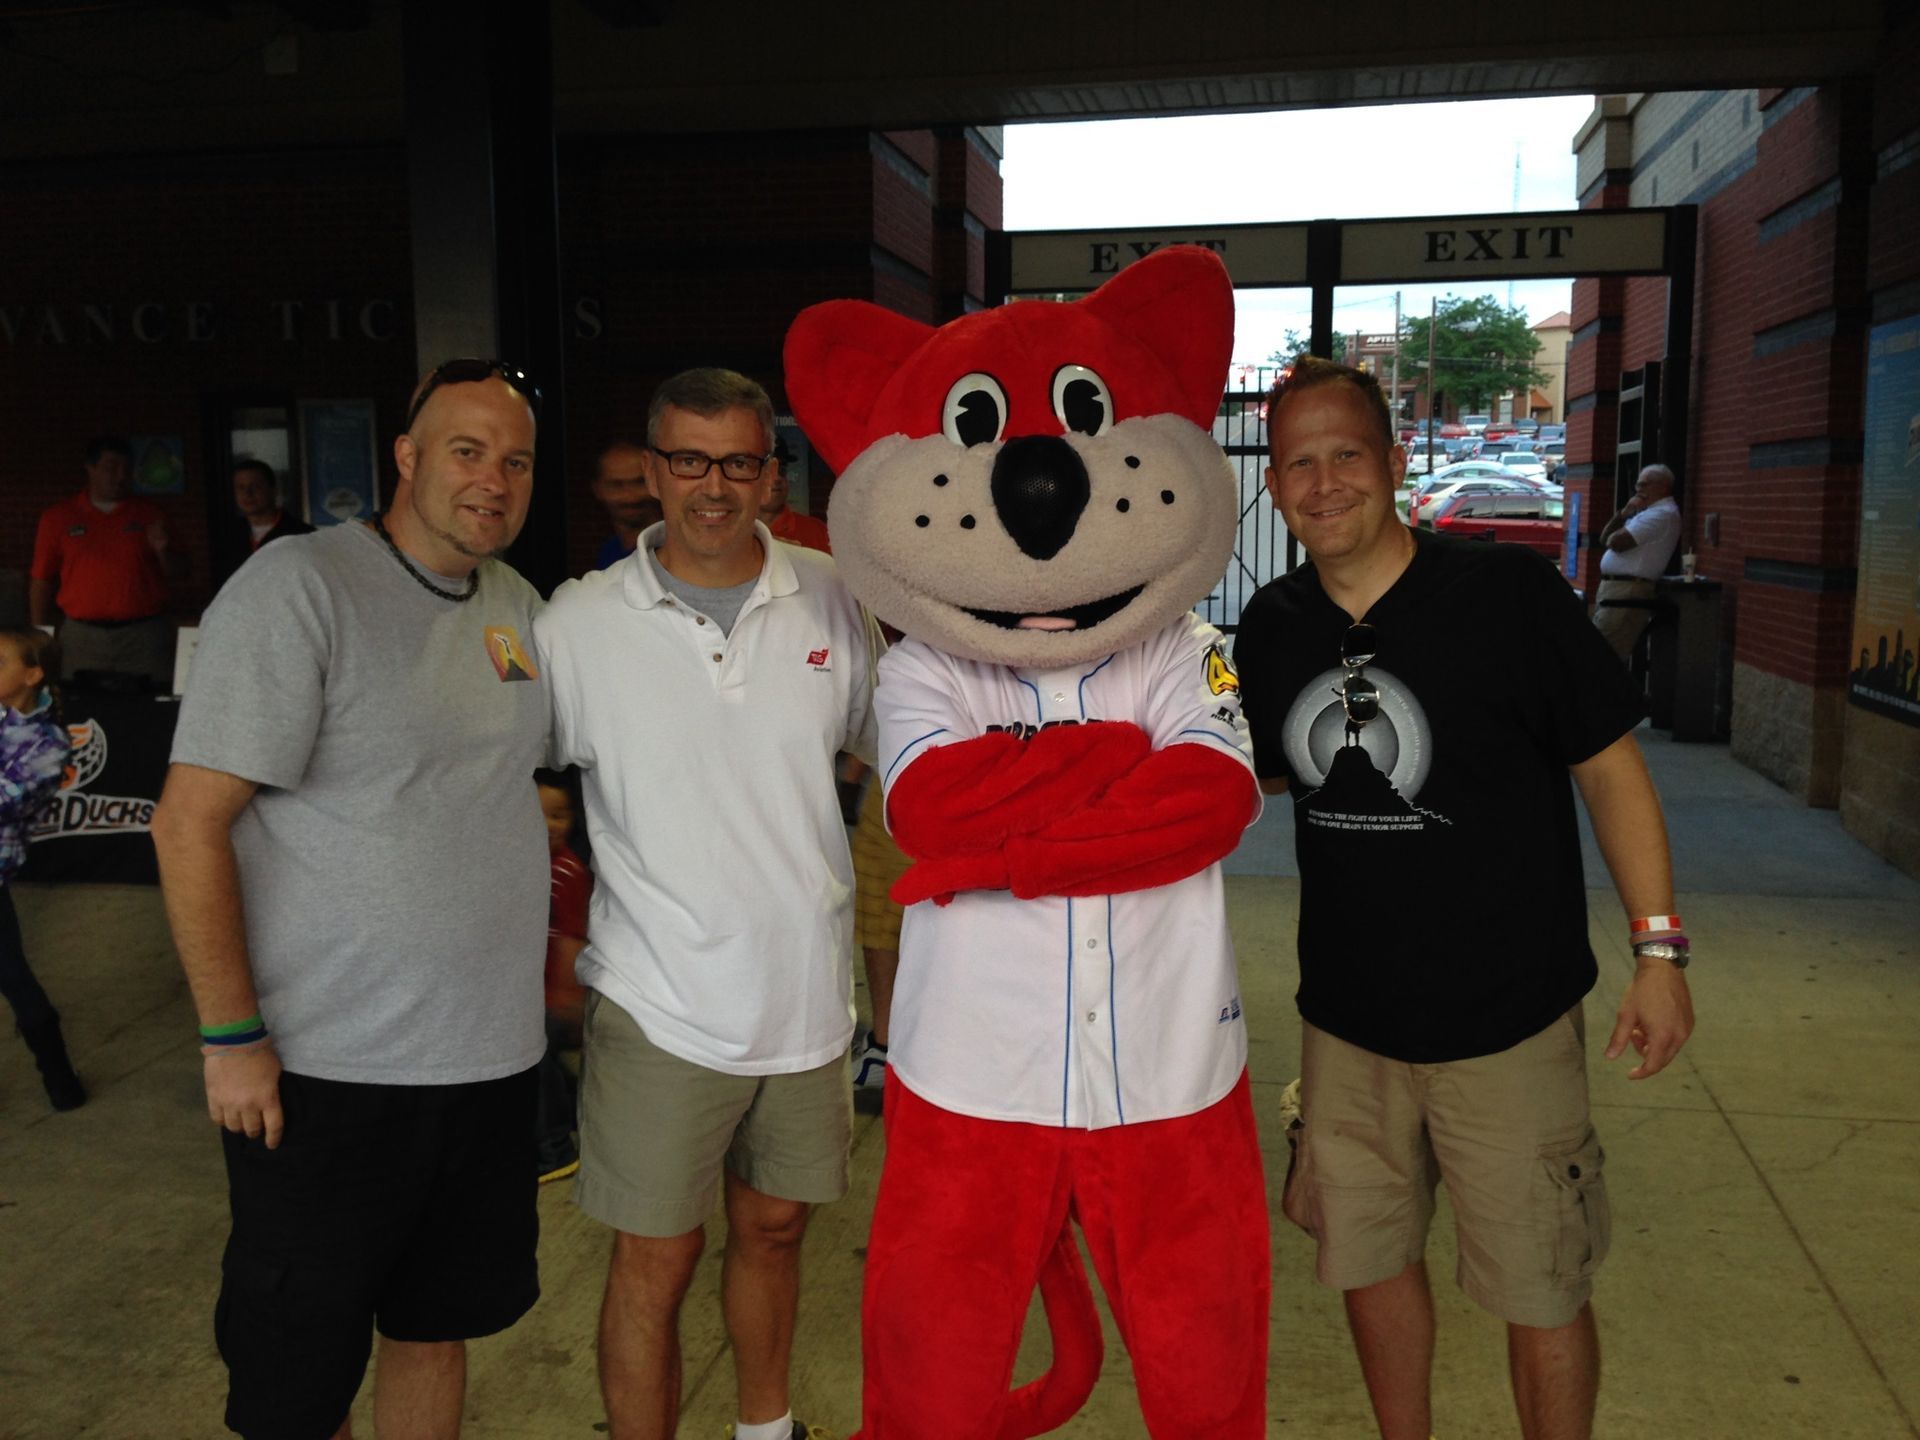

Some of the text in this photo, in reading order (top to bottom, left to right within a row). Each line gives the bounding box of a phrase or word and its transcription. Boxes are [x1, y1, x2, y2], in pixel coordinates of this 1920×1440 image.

[1425, 226, 1574, 262] EXIT
[272, 297, 603, 342] TICS
[1363, 823, 1389, 831] TUMOR
[1390, 823, 1424, 831] SUPPORT
